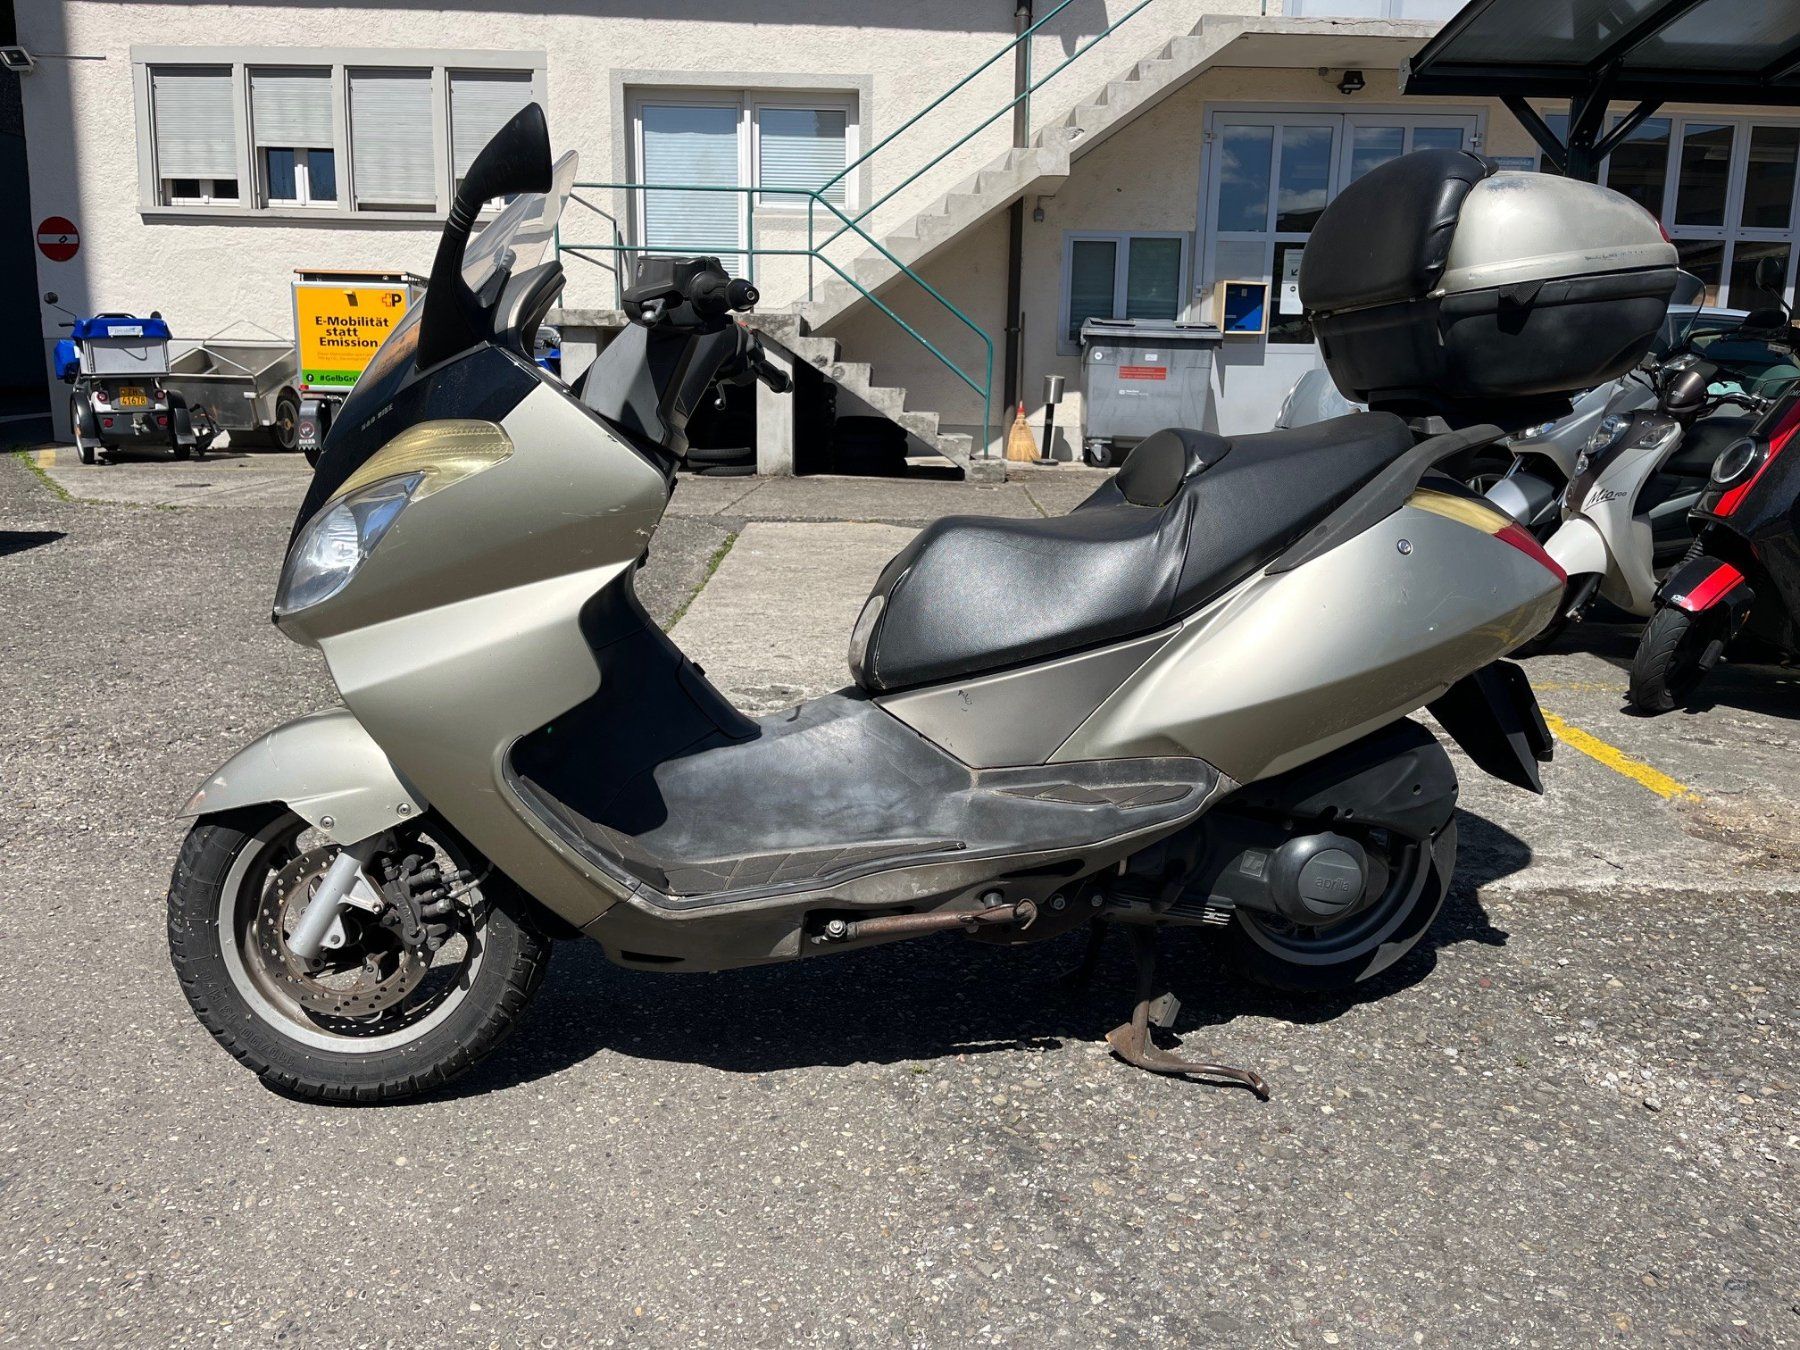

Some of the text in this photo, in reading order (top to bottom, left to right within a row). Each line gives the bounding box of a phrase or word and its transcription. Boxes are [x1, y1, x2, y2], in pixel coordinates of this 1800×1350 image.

[315, 316, 389, 327] E-Mobilität
[326, 327, 358, 336] statt
[1586, 489, 1614, 506] Mio
[1315, 877, 1350, 892] aprilia
